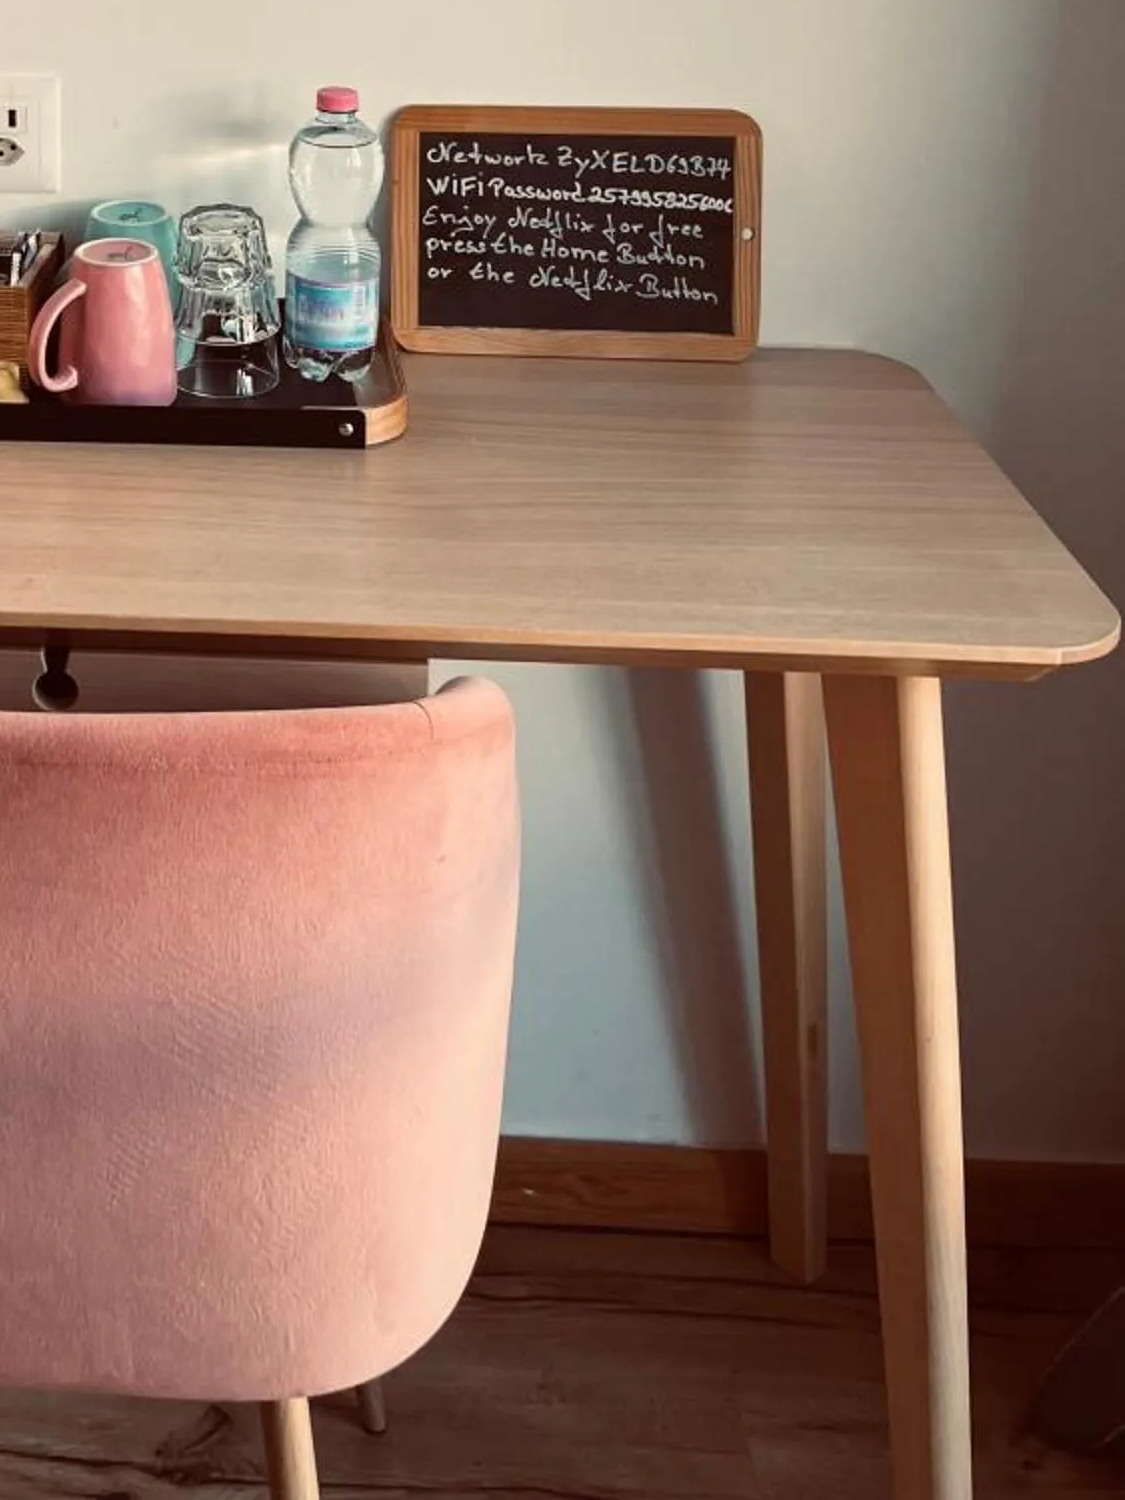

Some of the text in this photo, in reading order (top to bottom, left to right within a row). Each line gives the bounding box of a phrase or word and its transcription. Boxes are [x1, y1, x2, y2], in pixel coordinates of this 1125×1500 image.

[426, 142, 549, 166] Network
[422, 205, 704, 248] Enjoy Netflix for free
[426, 232, 705, 270] press the Home Button
[427, 261, 719, 305] or the Netflix Button
